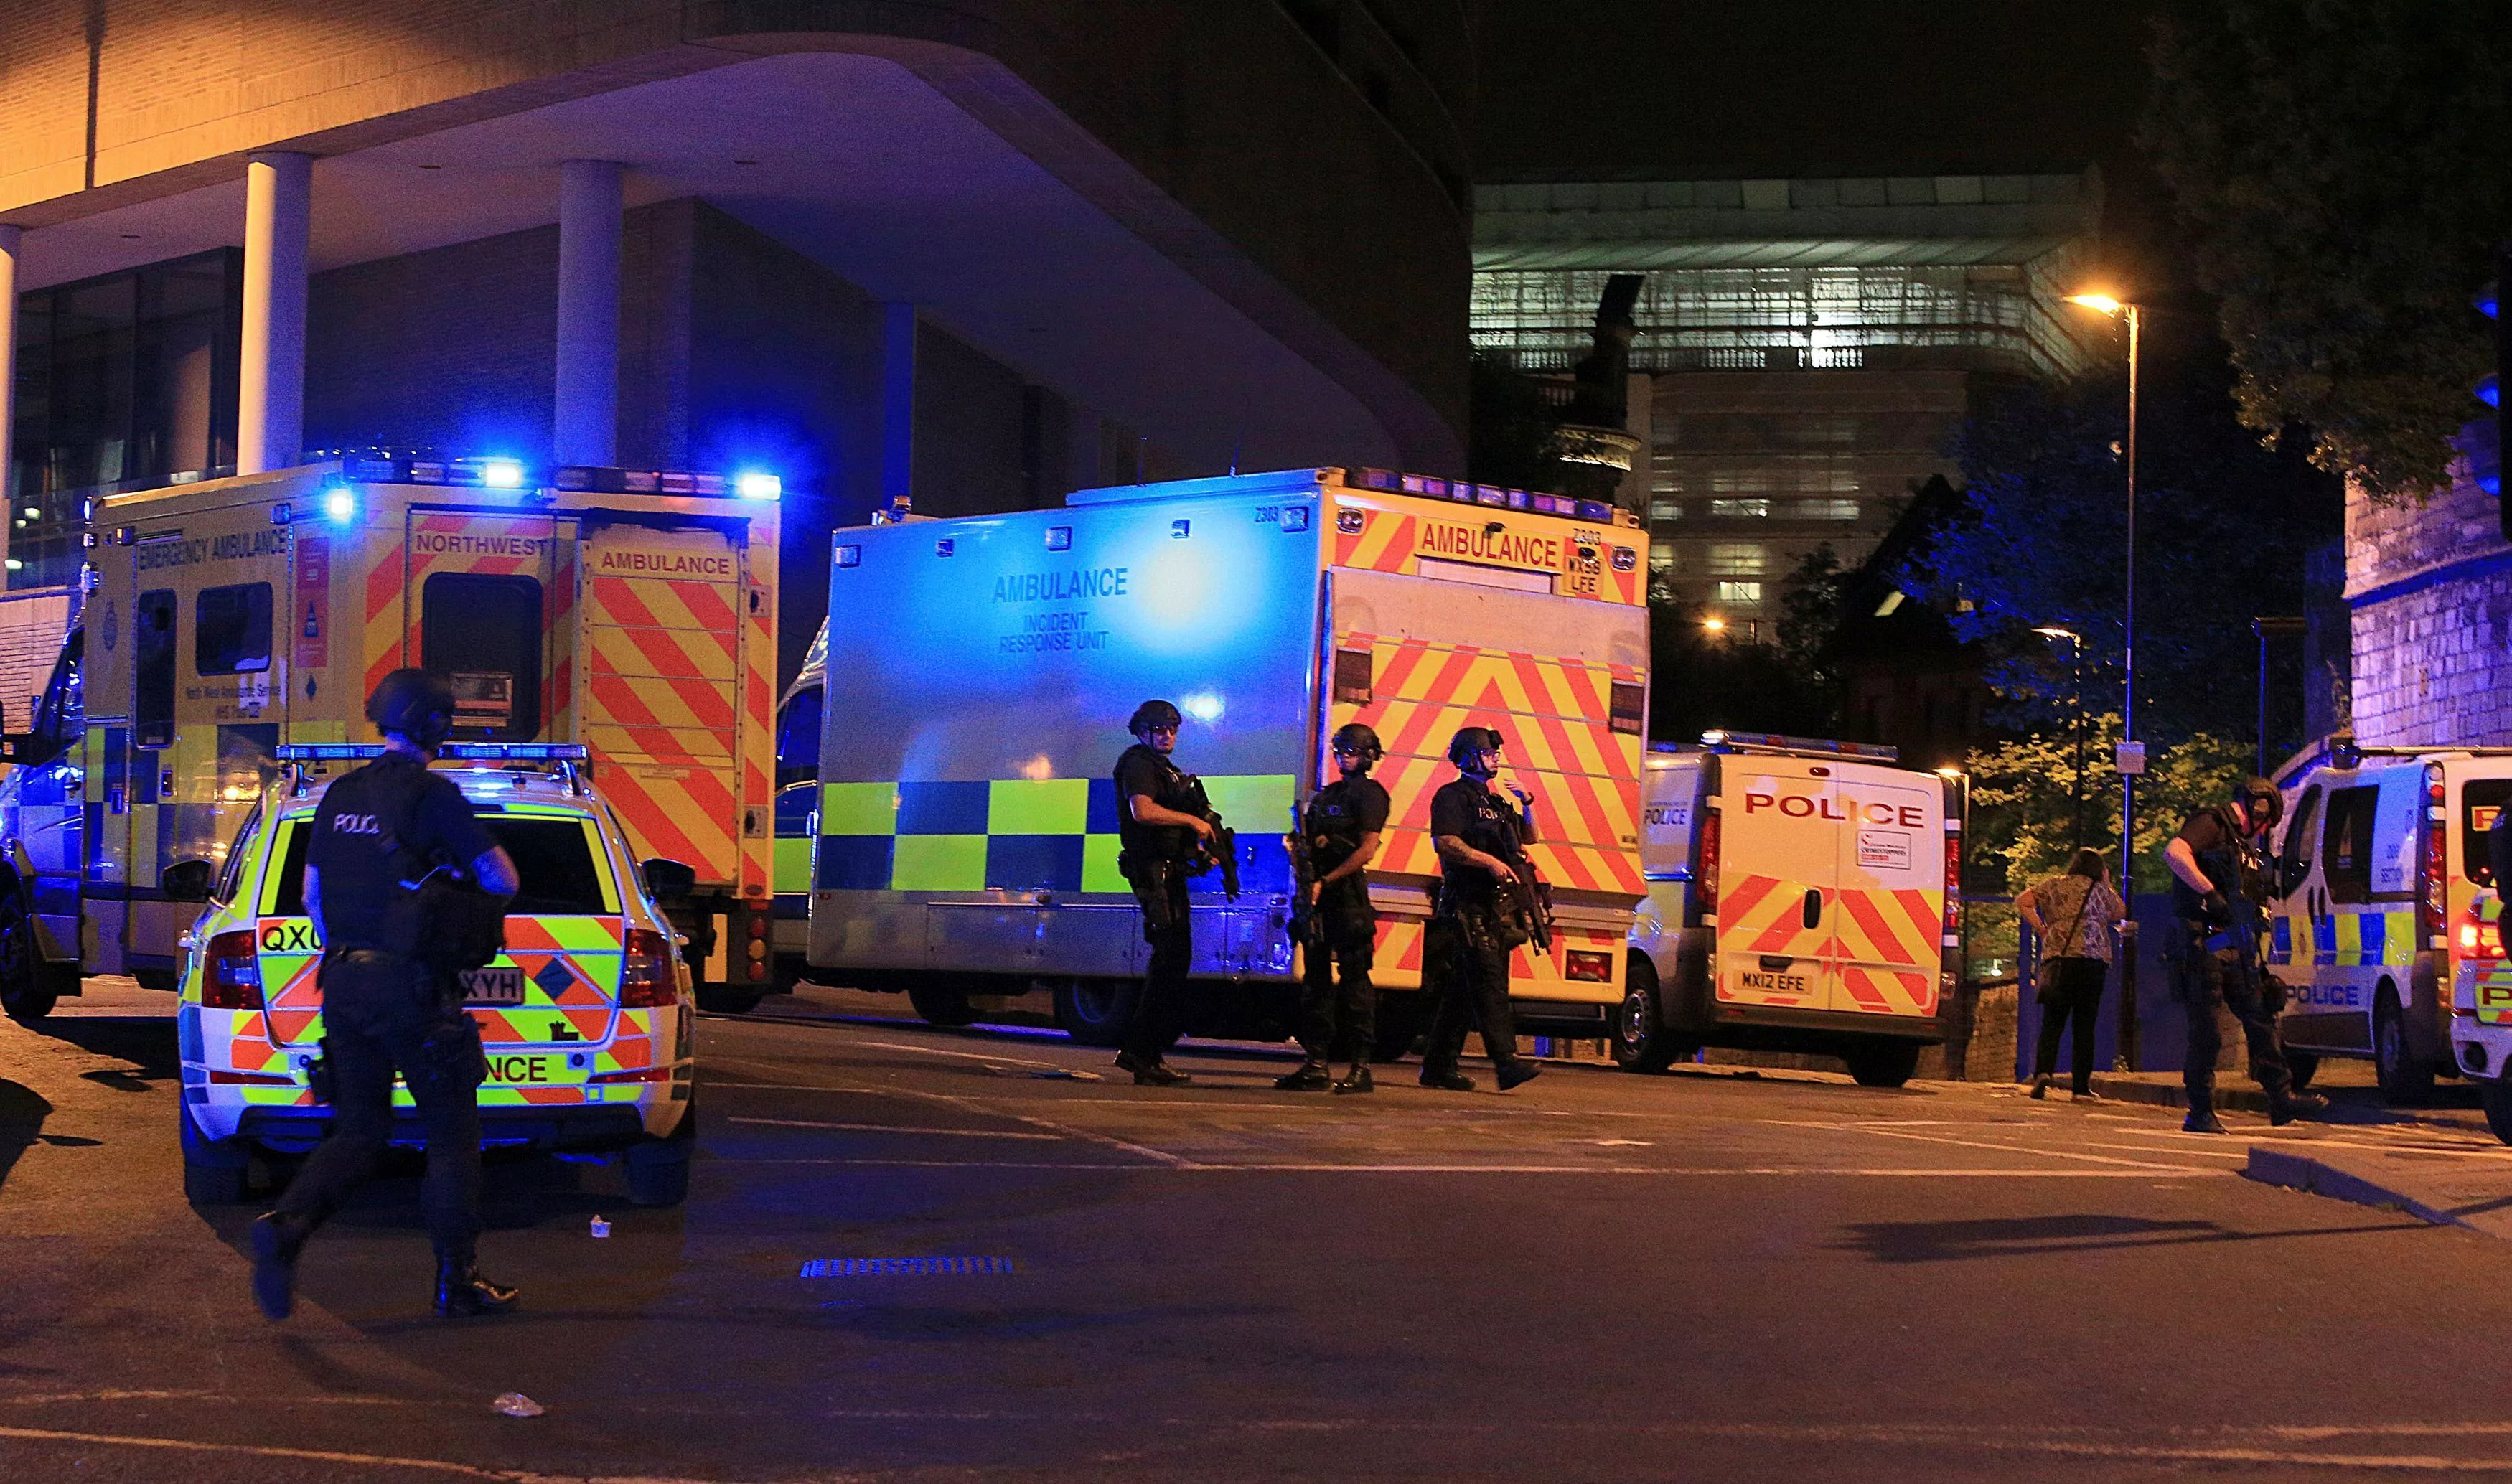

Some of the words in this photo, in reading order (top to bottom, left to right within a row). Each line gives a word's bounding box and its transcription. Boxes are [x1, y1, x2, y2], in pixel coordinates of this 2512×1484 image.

[212, 529, 286, 558] AMBULANCE
[416, 535, 548, 556] NORTHWEST
[1422, 523, 1557, 566] AMBULANCE
[601, 552, 730, 575] AMBULANCE
[993, 568, 1128, 603] AMBULANCE
[1023, 611, 1089, 632] INCIDENT
[998, 631, 1073, 654] RESPONSE
[1078, 631, 1110, 650] UNIT
[1644, 809, 1687, 825] POLICE
[1745, 793, 1925, 829] POLICE
[333, 813, 380, 834] POLIC
[1742, 972, 1773, 989] MX12
[1778, 975, 1805, 991] EFE
[2285, 984, 2359, 1006] POLICE
